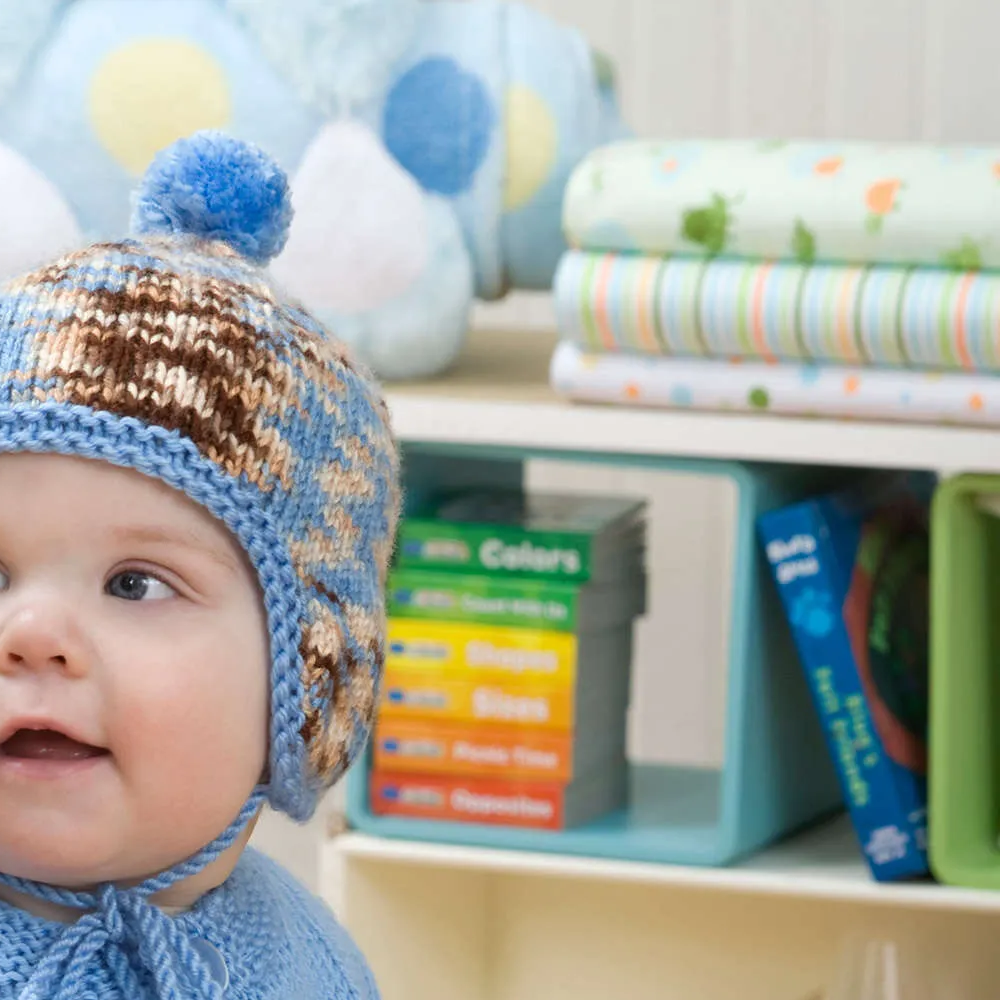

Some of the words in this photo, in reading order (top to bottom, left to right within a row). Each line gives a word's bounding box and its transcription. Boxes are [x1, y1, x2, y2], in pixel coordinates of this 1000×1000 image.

[479, 537, 581, 574] Colors
[466, 640, 558, 673] Shapes
[471, 688, 549, 723] Sizes
